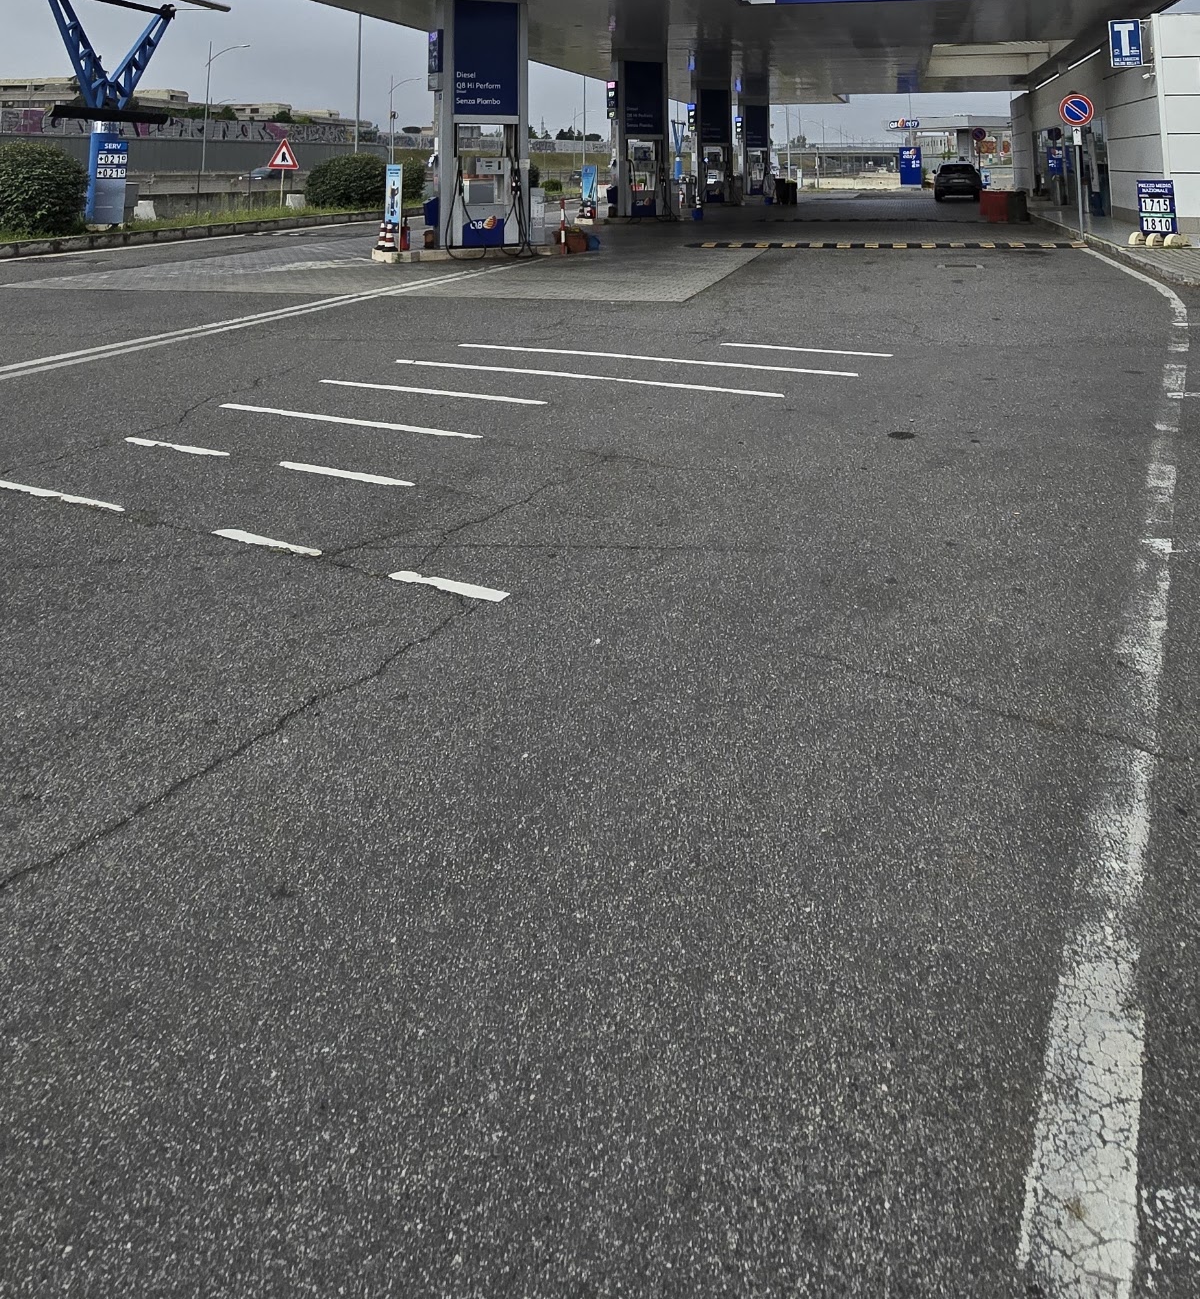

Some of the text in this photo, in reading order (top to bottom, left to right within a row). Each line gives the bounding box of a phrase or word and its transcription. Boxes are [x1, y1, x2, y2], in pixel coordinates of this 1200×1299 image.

[1114, 23, 1134, 56] T
[470, 221, 482, 229] Q8
[1144, 218, 1171, 231] 1.810
